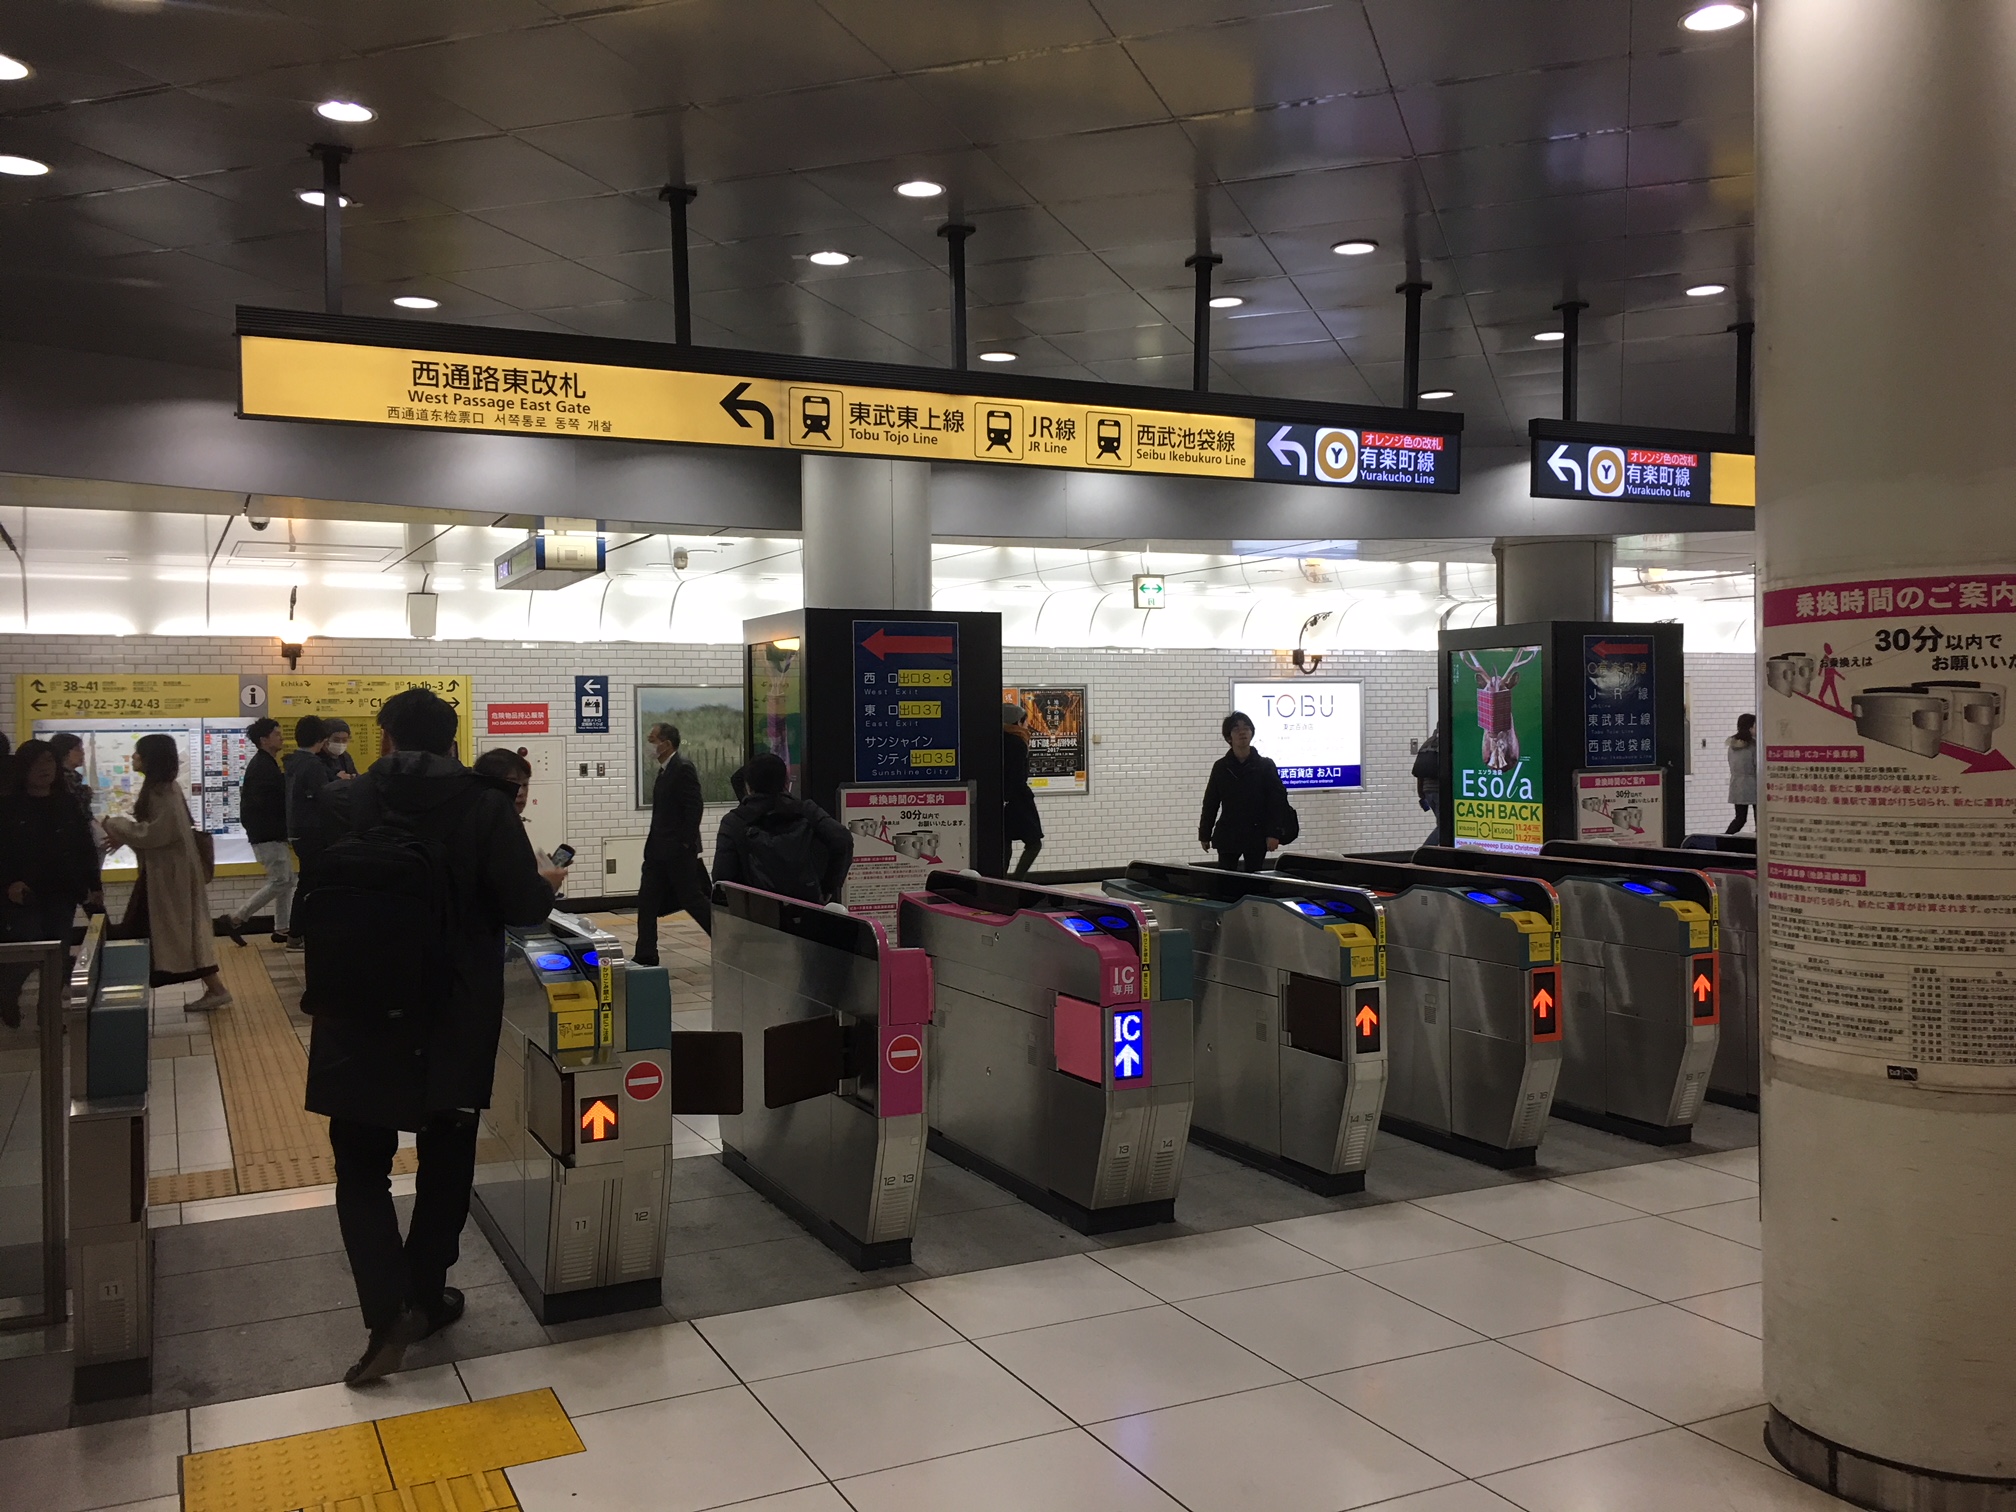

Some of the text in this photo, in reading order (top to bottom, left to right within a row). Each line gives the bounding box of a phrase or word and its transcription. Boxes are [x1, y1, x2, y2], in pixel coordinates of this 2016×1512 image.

[411, 360, 587, 399] 西通路東改札
[407, 390, 591, 415] West Passage East Gate
[387, 406, 613, 433] 西通道东检票口 서쪽통로 동쪽 개찰
[849, 402, 965, 433] 東武東上線
[1028, 416, 1076, 441] JR線
[848, 428, 938, 445] Tobu Tojo Line
[1136, 424, 1236, 453] 西武池袋線
[1365, 434, 1442, 450] オレンジ色の改札
[1028, 441, 1067, 454] JR Line
[1136, 449, 1246, 466] Seibu Ikebukuro Line
[1331, 448, 1343, 464] Y
[1360, 447, 1435, 473] 有楽町線
[1631, 451, 1696, 466] オレンジ色の改札
[1360, 470, 1435, 484] Yurakucho Line
[1601, 465, 1612, 479] Y
[1627, 464, 1691, 487] 有楽町線
[1627, 485, 1691, 498] Yurakucho Line
[1795, 581, 2016, 618] 乗換時間のご案内
[1875, 625, 2002, 653] 30分以内で
[1262, 694, 1333, 718] TOBU
[1588, 713, 1651, 726] 東武東上線
[865, 736, 933, 748] サンシャイン
[1588, 739, 1652, 753] 西武池袋線
[877, 753, 909, 765] シティ
[926, 768, 949, 776] City
[1462, 762, 1533, 800] Esola
[869, 793, 945, 806] 乗換時間のご案内
[1114, 966, 1134, 984] IC
[1112, 984, 1134, 995] 専用
[574, 1022, 593, 1031] 投入口
[1114, 1015, 1140, 1042] IC
[1350, 1112, 1374, 1123] 14 15
[1118, 1145, 1129, 1154] 13
[1163, 1140, 1173, 1148] 14
[884, 1174, 914, 1186] 12 13
[634, 1210, 649, 1222] 12
[575, 1221, 587, 1231] 11
[103, 1285, 119, 1296] 11
